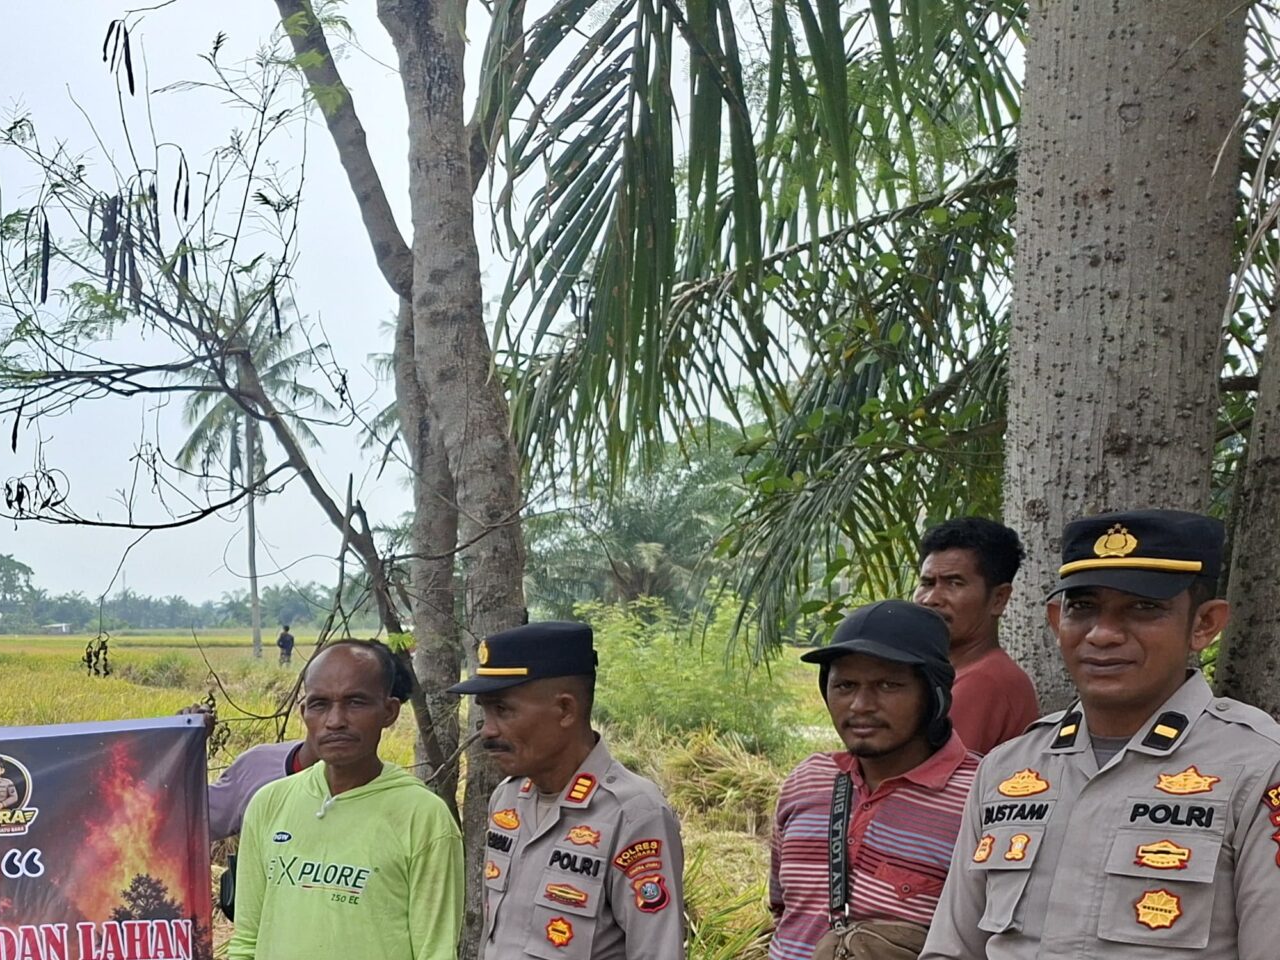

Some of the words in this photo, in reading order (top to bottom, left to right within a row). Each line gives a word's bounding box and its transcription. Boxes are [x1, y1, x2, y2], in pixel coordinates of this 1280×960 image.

[1130, 804, 1214, 828] POLRI
[616, 842, 657, 865] POLRES
[832, 819, 844, 864] LOLA
[549, 850, 601, 877] POLRI
[331, 894, 346, 902] 250
[349, 896, 360, 905] EC
